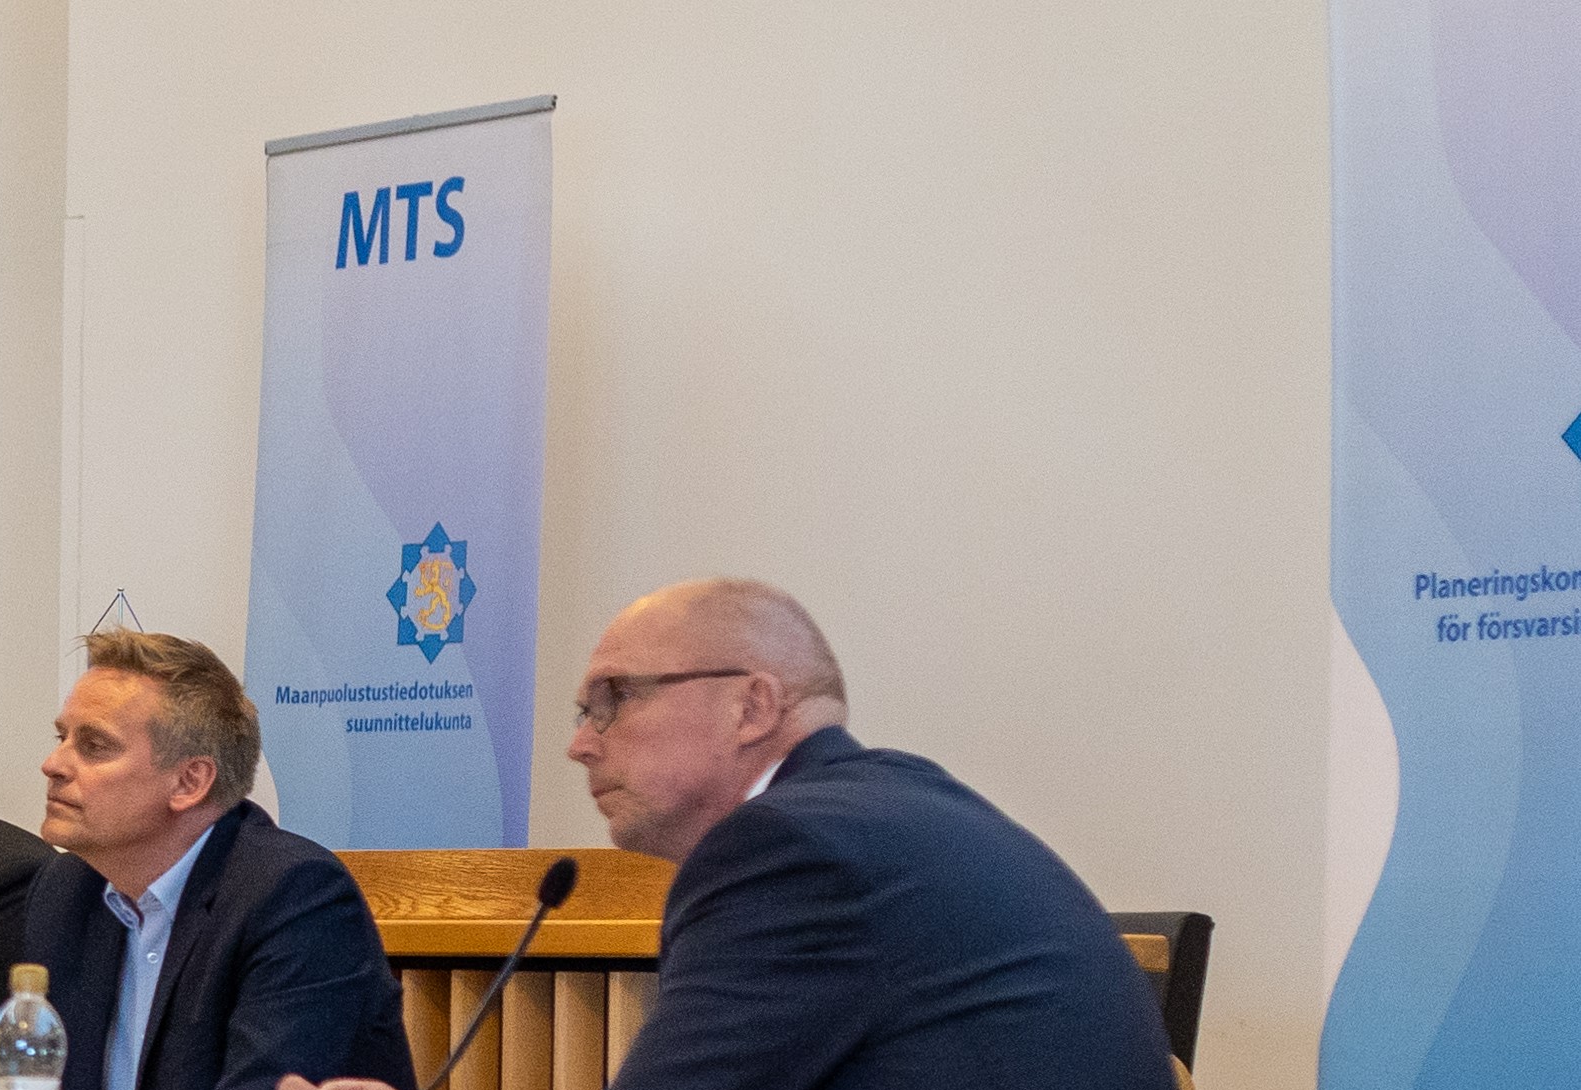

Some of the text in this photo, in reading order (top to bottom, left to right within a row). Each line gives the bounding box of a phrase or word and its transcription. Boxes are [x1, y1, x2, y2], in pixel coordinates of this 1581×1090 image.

[336, 176, 465, 269] MTS
[1437, 613, 1470, 642] för
[1477, 608, 1581, 640] försvarsi
[275, 679, 473, 707] Maanpuolustustiedotuksen
[345, 711, 472, 733] suunnittelukunta
